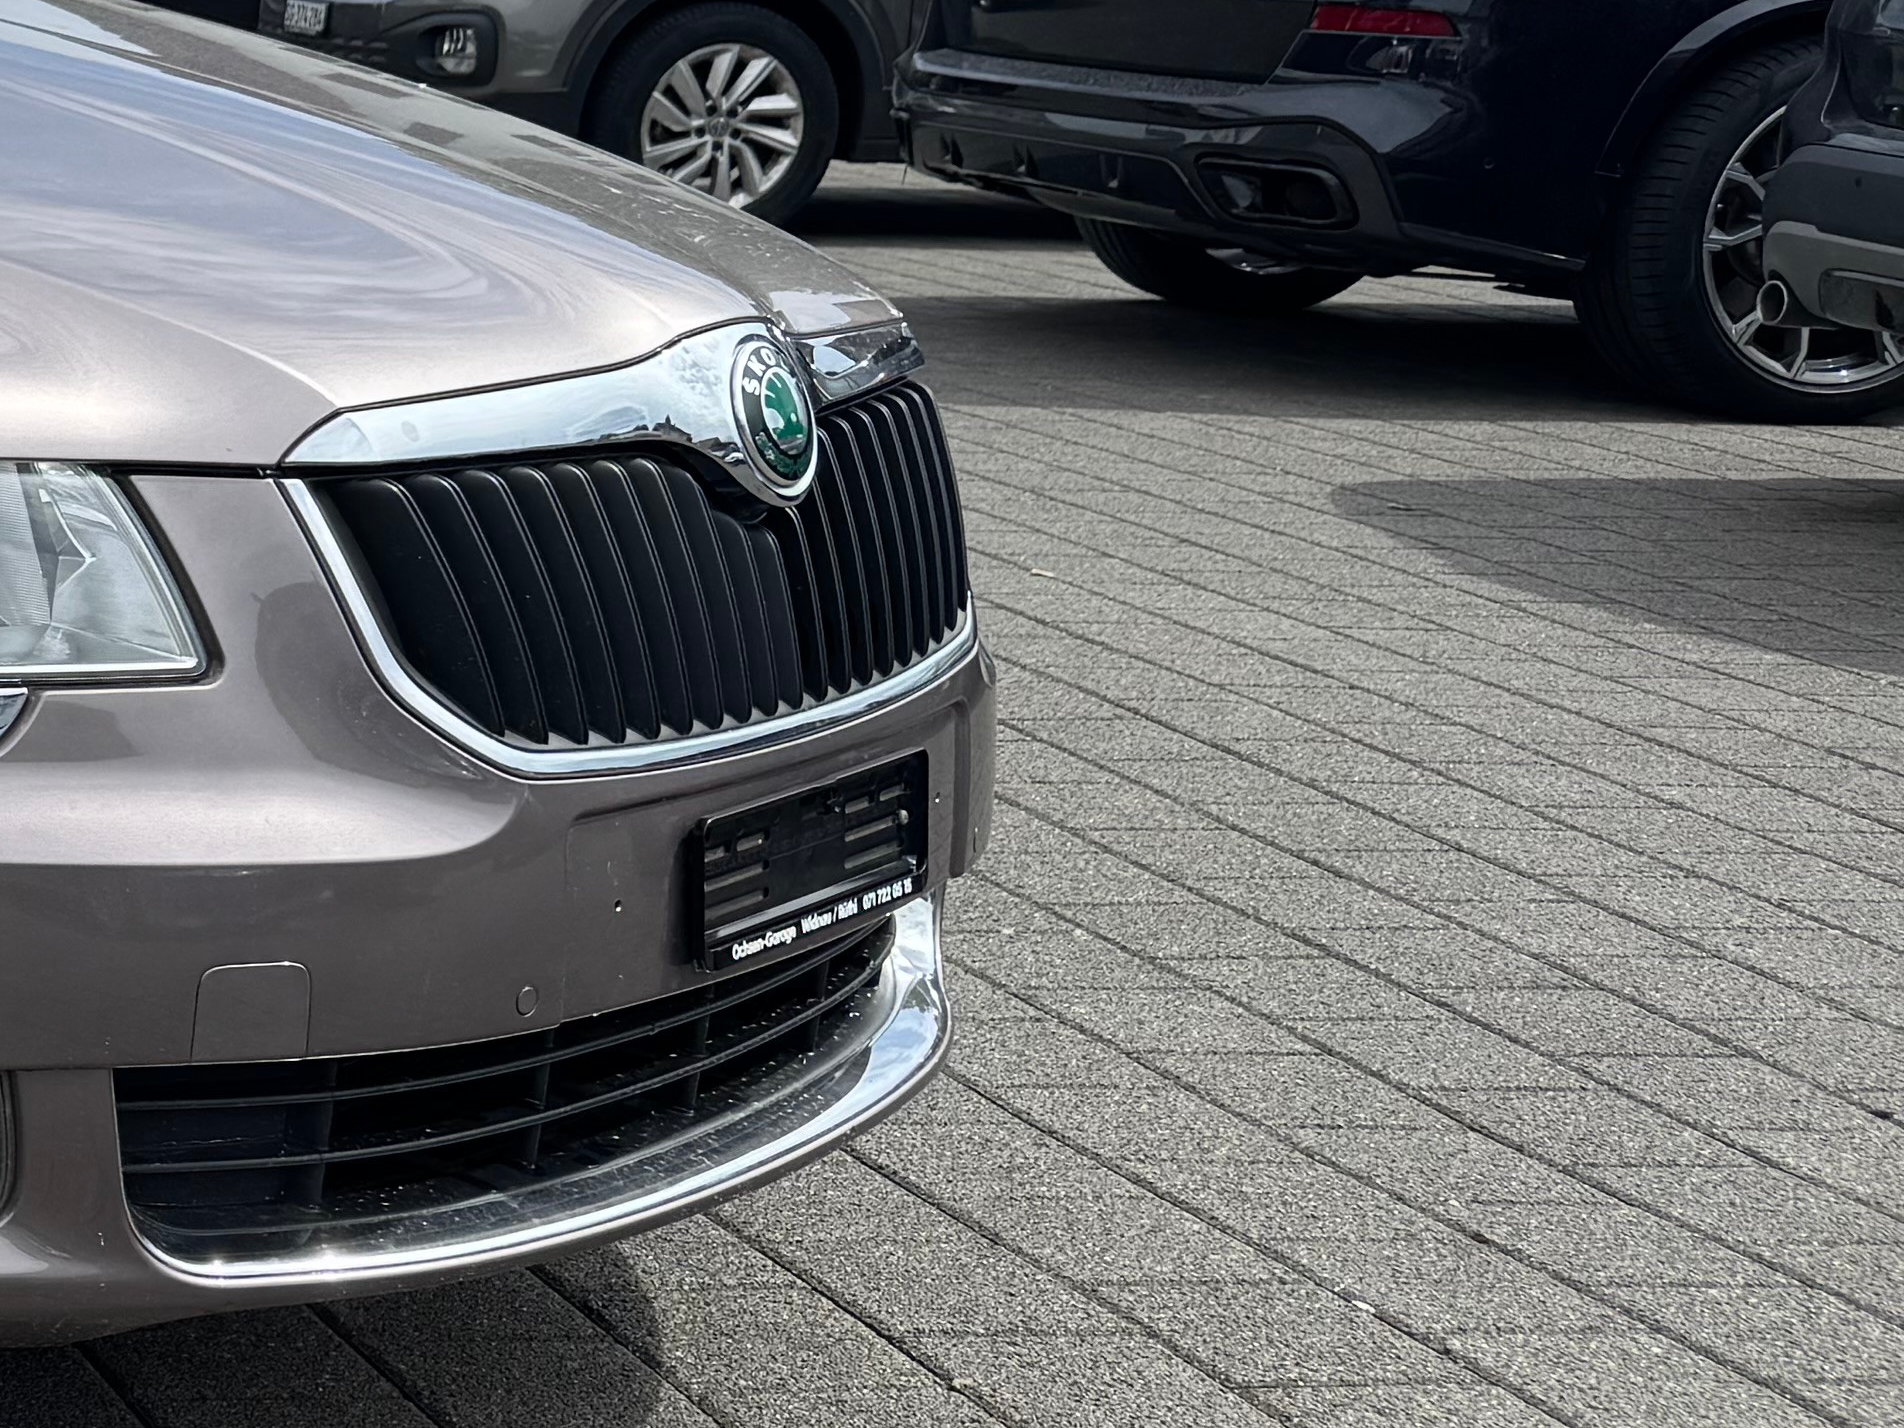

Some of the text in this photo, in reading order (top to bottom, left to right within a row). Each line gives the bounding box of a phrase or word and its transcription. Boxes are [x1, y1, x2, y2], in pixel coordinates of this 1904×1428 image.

[732, 926, 797, 961] Ochsen-Garage
[863, 892, 877, 910] 071
[877, 886, 892, 905] 722
